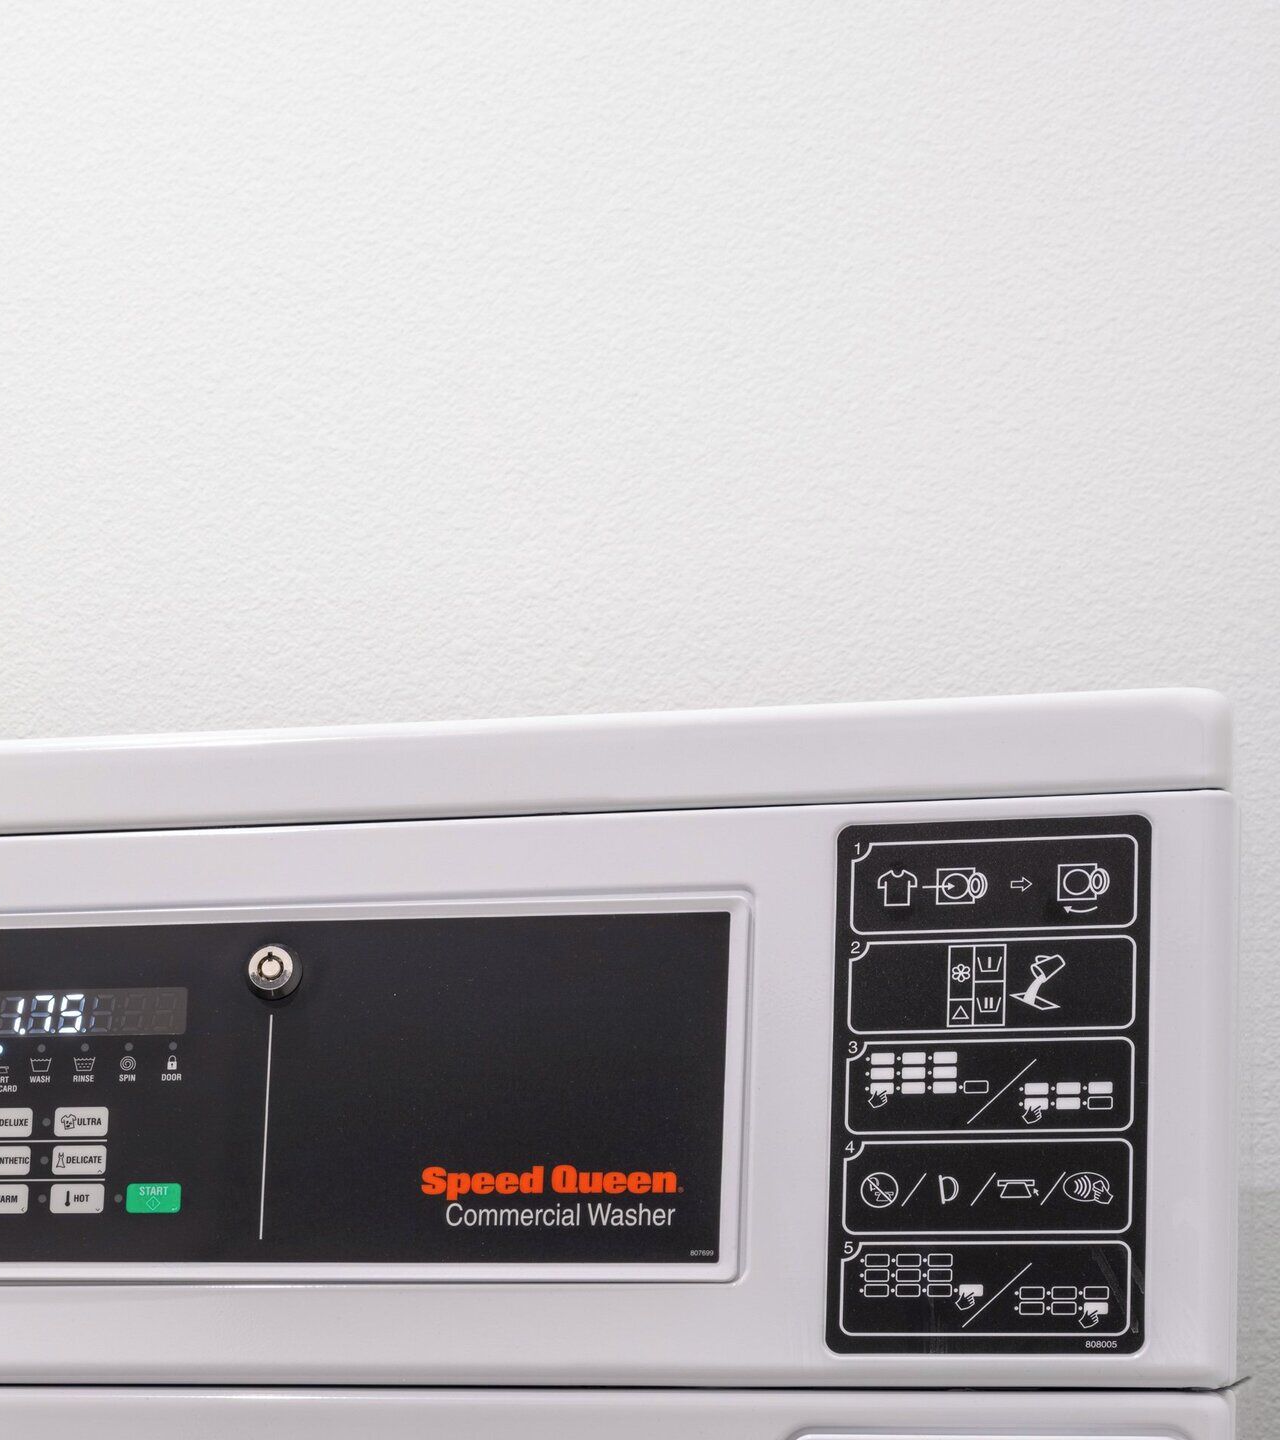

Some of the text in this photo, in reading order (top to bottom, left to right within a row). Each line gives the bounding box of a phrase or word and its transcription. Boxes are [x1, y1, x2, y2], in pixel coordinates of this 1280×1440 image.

[854, 843, 861, 855] 1
[850, 941, 861, 954] 2
[848, 1041, 858, 1053] 3
[29, 1075, 51, 1083] WASH
[72, 1074, 95, 1083] RINSE
[118, 1074, 136, 1082] SPIN
[161, 1073, 182, 1081] DOOR
[76, 1117, 102, 1127] ULTRA
[844, 1140, 855, 1153] 4
[65, 1155, 102, 1165] DELICATE
[421, 1164, 677, 1200] Speed Queen
[138, 1185, 169, 1197] START
[73, 1193, 90, 1203] HOT
[445, 1202, 676, 1227] Commercial Washer
[843, 1241, 854, 1254] 5
[1085, 1340, 1118, 1349] 808005
